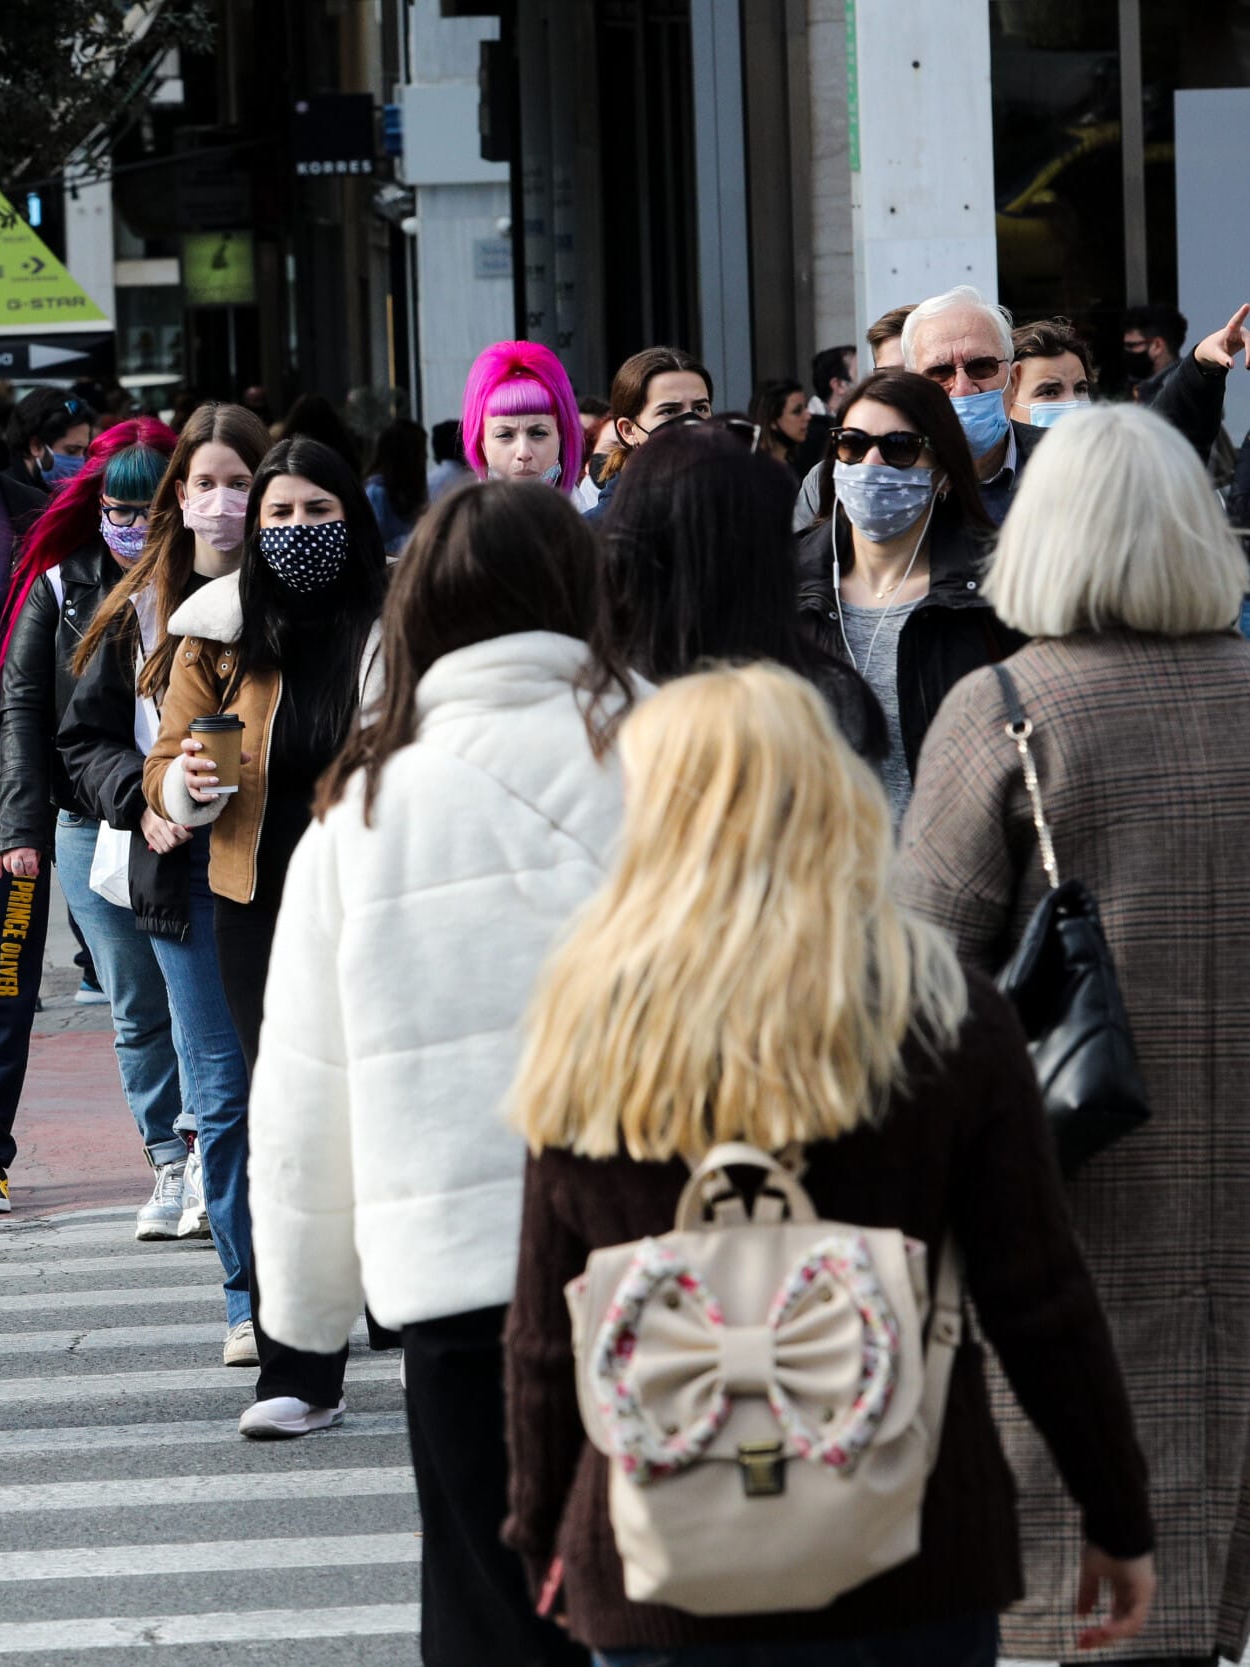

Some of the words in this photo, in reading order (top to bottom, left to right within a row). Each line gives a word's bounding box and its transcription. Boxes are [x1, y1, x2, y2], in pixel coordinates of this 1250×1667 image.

[296, 159, 373, 175] KORRES
[6, 295, 87, 311] G-STAR
[2, 880, 36, 940] PRINCE
